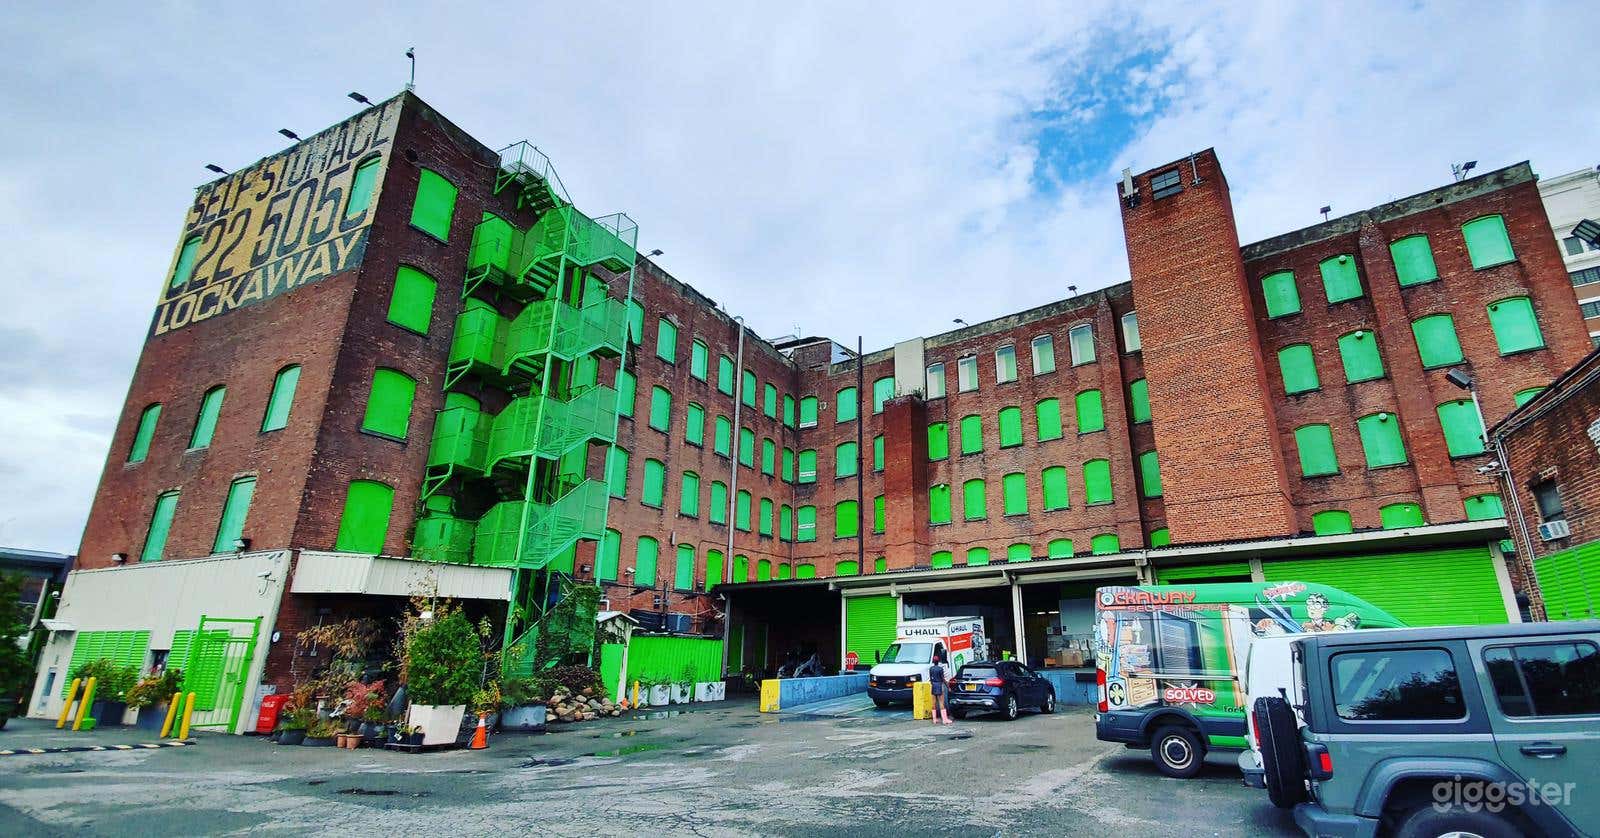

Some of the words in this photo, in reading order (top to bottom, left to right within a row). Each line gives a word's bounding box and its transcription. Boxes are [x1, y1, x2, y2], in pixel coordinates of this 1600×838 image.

[165, 208, 251, 300] 22
[154, 231, 362, 335] LOCKAWAY
[845, 657, 858, 665] STOP
[1166, 689, 1214, 701] SOLVED
